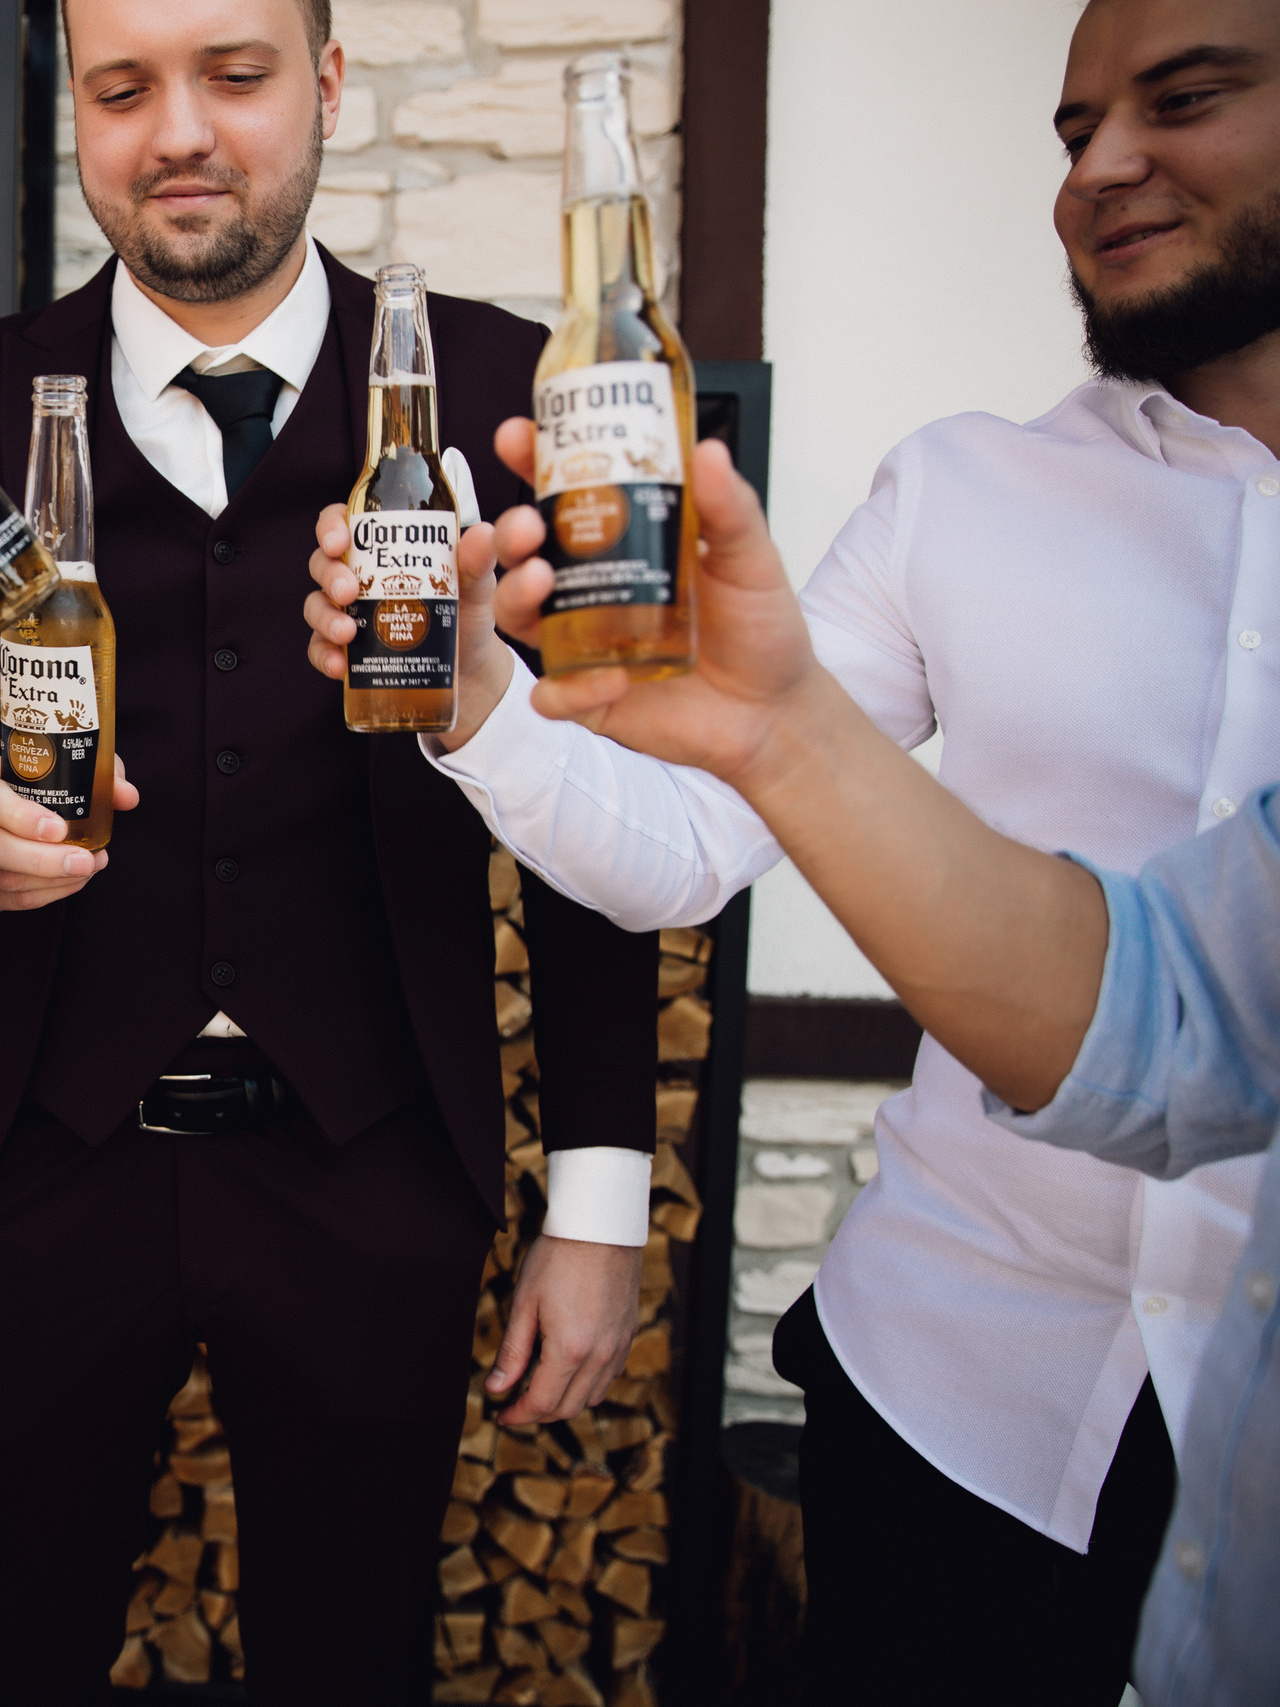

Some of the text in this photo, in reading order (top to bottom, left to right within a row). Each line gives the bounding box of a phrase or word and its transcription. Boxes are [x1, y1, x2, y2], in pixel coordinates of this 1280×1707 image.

[554, 421, 627, 449] Extra
[354, 518, 450, 554] Corona
[377, 548, 432, 567] Extra
[394, 604, 408, 613] LA
[379, 613, 424, 623] CERVEZA
[390, 622, 413, 631] MAS
[390, 631, 413, 641] FINA
[0, 644, 81, 681] Corona
[363, 656, 388, 664] IMPORTED
[389, 656, 404, 664] BEER
[405, 656, 421, 664] FROM
[351, 664, 381, 673] CERVECERIA
[9, 677, 58, 703] Extra
[22, 737, 34, 746] LA
[11, 743, 50, 756] CERVEZA
[71, 749, 85, 760] BEER
[19, 755, 39, 765] MAS
[18, 763, 39, 773] FINA
[18, 786, 30, 794] BEER
[31, 788, 46, 796] FROM
[52, 797, 65, 805] R.L.
[65, 796, 74, 805] DE
[74, 795, 85, 804] C.V.
